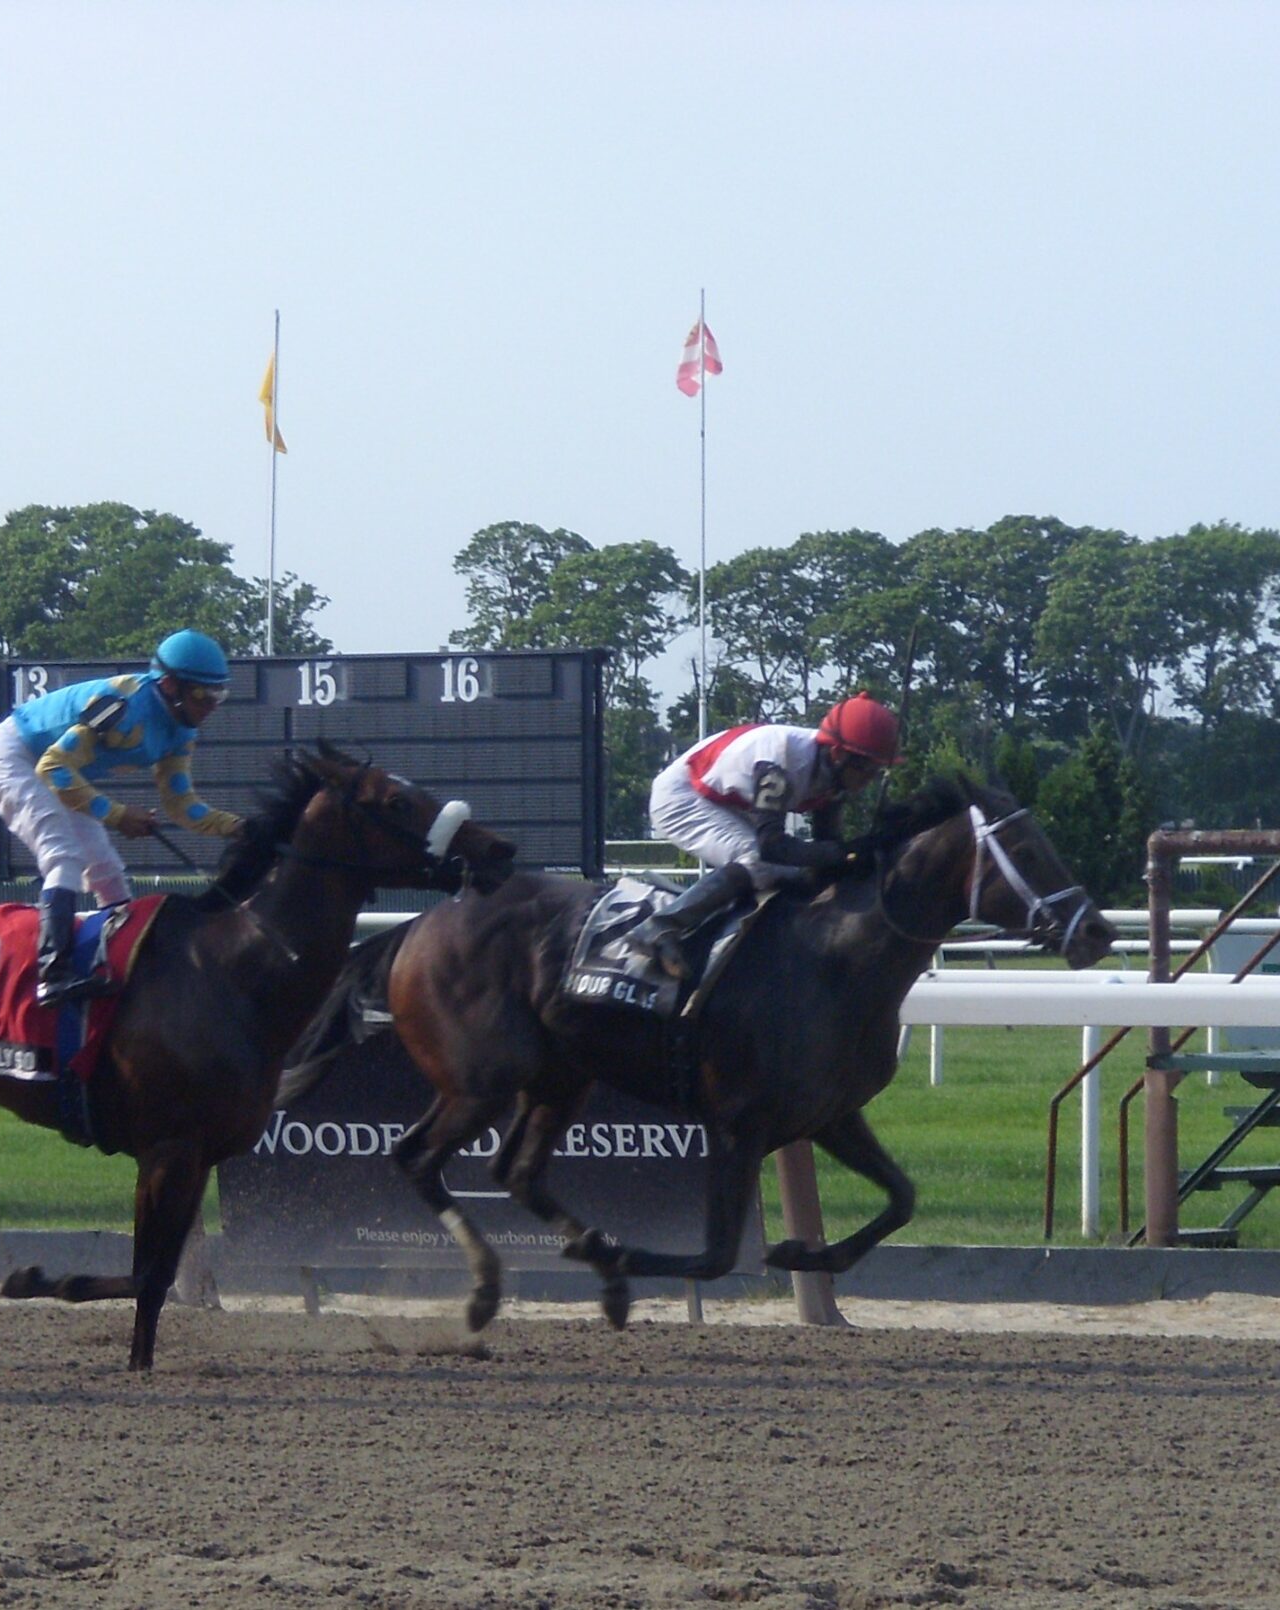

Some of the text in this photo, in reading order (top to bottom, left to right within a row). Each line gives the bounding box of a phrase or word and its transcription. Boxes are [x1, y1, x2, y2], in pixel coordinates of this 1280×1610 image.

[12, 666, 48, 709] 13
[298, 661, 336, 706] 15
[440, 658, 480, 703] 16
[756, 771, 786, 810] 2
[553, 1123, 709, 1158] ESERV
[357, 1227, 399, 1241] Please
[402, 1229, 438, 1247] enjoy
[486, 1231, 536, 1245] ourbon
